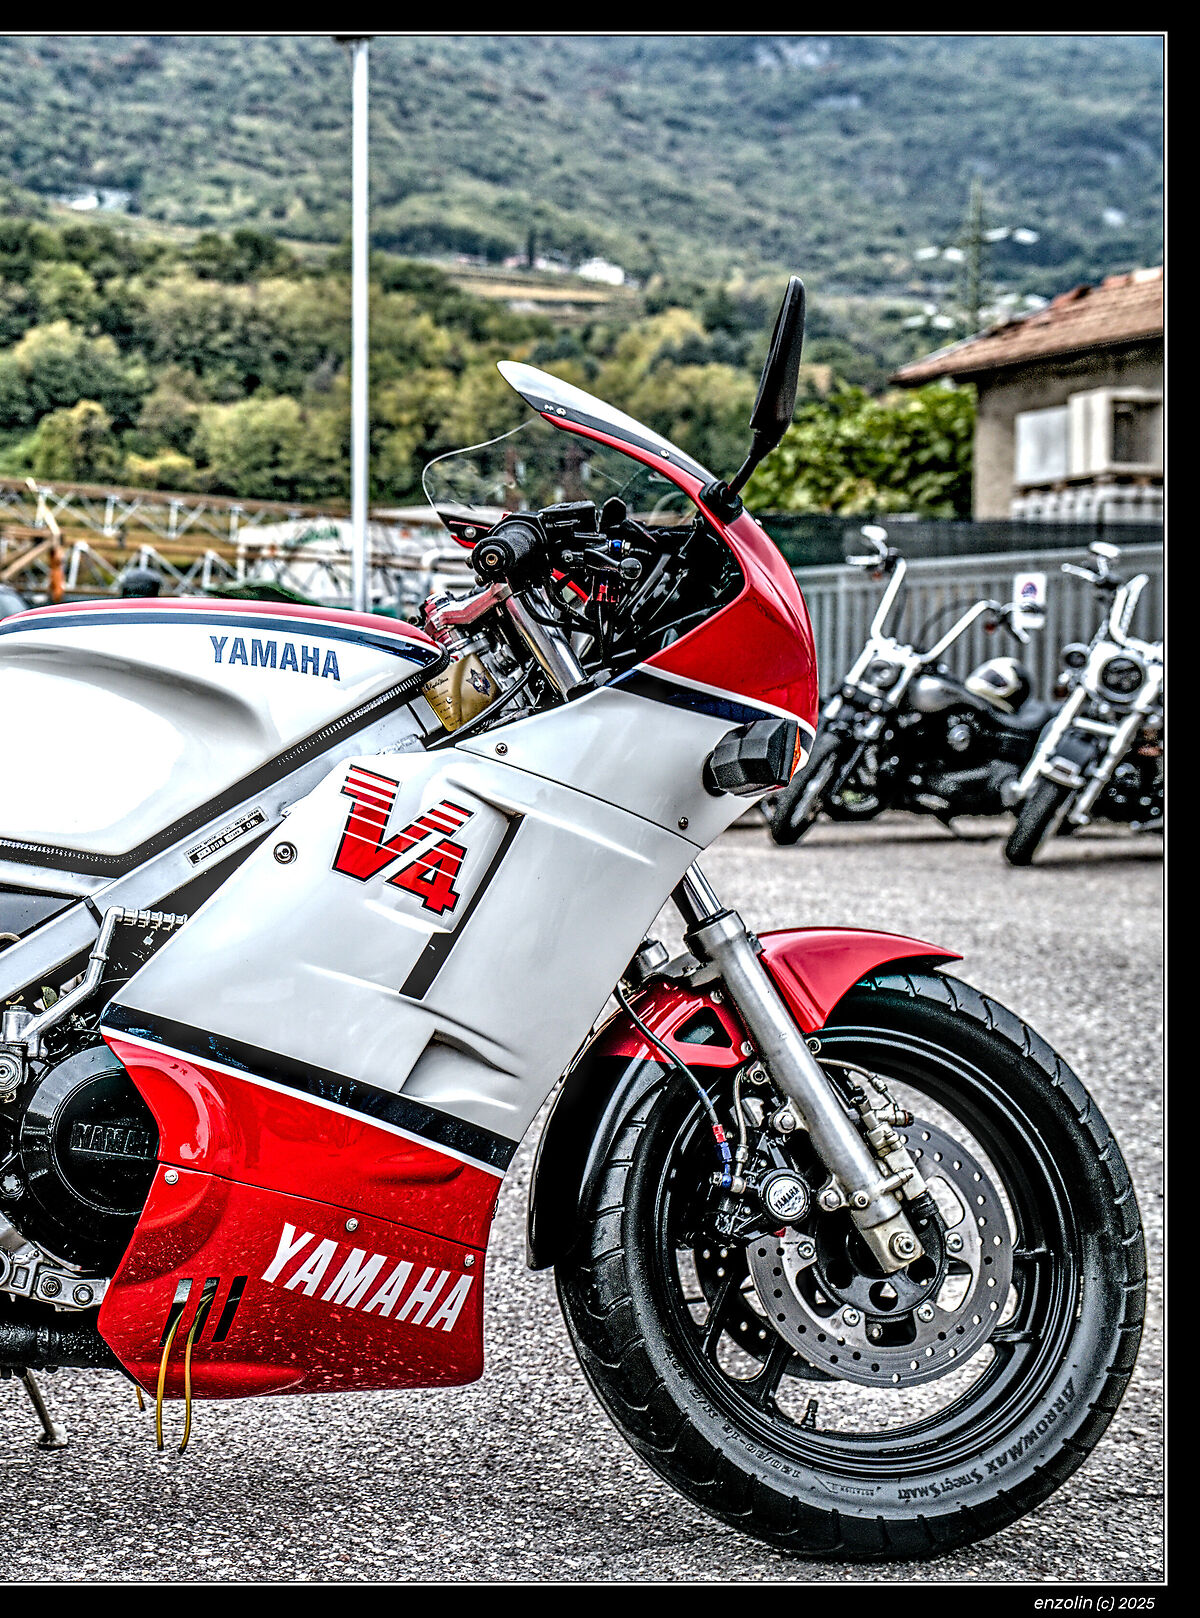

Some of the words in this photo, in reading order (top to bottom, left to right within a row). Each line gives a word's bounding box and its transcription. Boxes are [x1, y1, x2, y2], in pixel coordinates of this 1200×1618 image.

[209, 635, 341, 682] YAMAHA
[330, 763, 475, 917] V4
[773, 1185, 800, 1210] YAMAHA
[261, 1222, 475, 1333] YAMAHA
